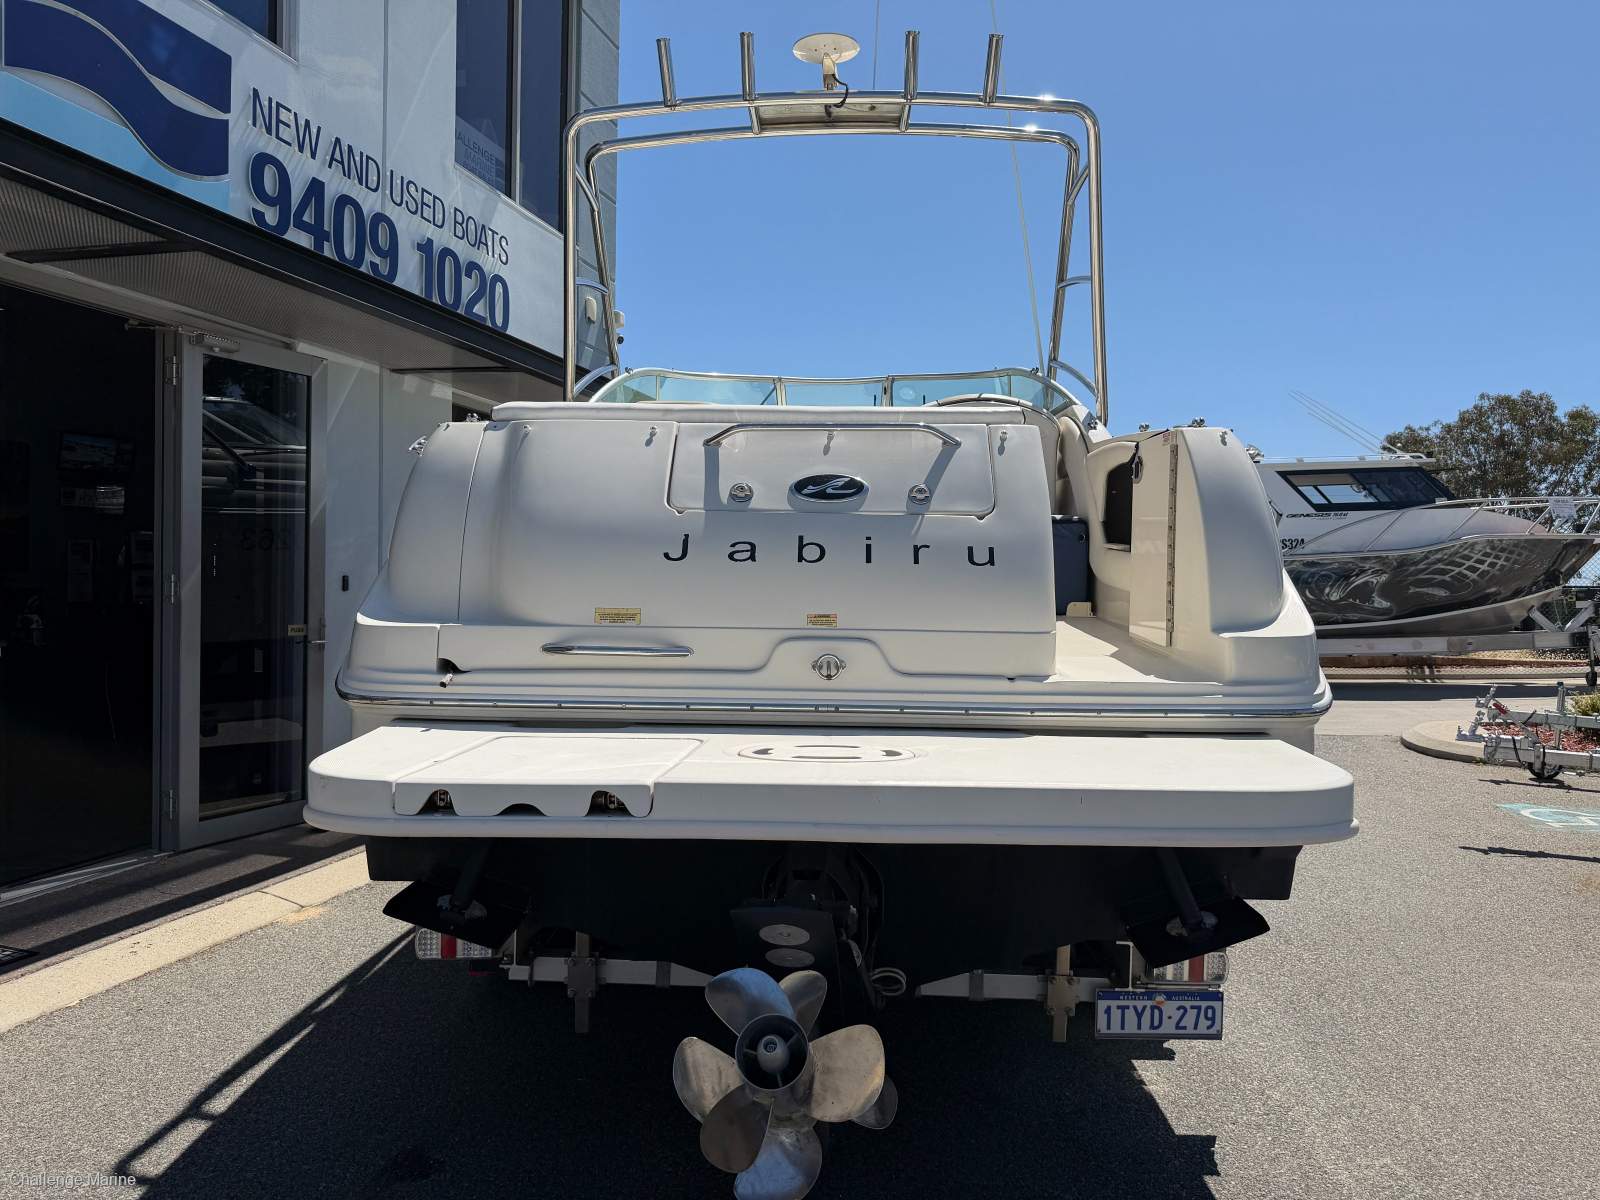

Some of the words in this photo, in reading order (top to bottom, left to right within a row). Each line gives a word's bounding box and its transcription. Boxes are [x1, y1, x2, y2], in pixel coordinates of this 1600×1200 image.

[250, 152, 399, 284] 9409
[416, 237, 510, 334] 1020
[252, 87, 322, 161] NEW
[328, 136, 381, 193] AND
[390, 169, 446, 229] USED
[453, 207, 509, 266] BOATS
[663, 533, 996, 567] Jabiru
